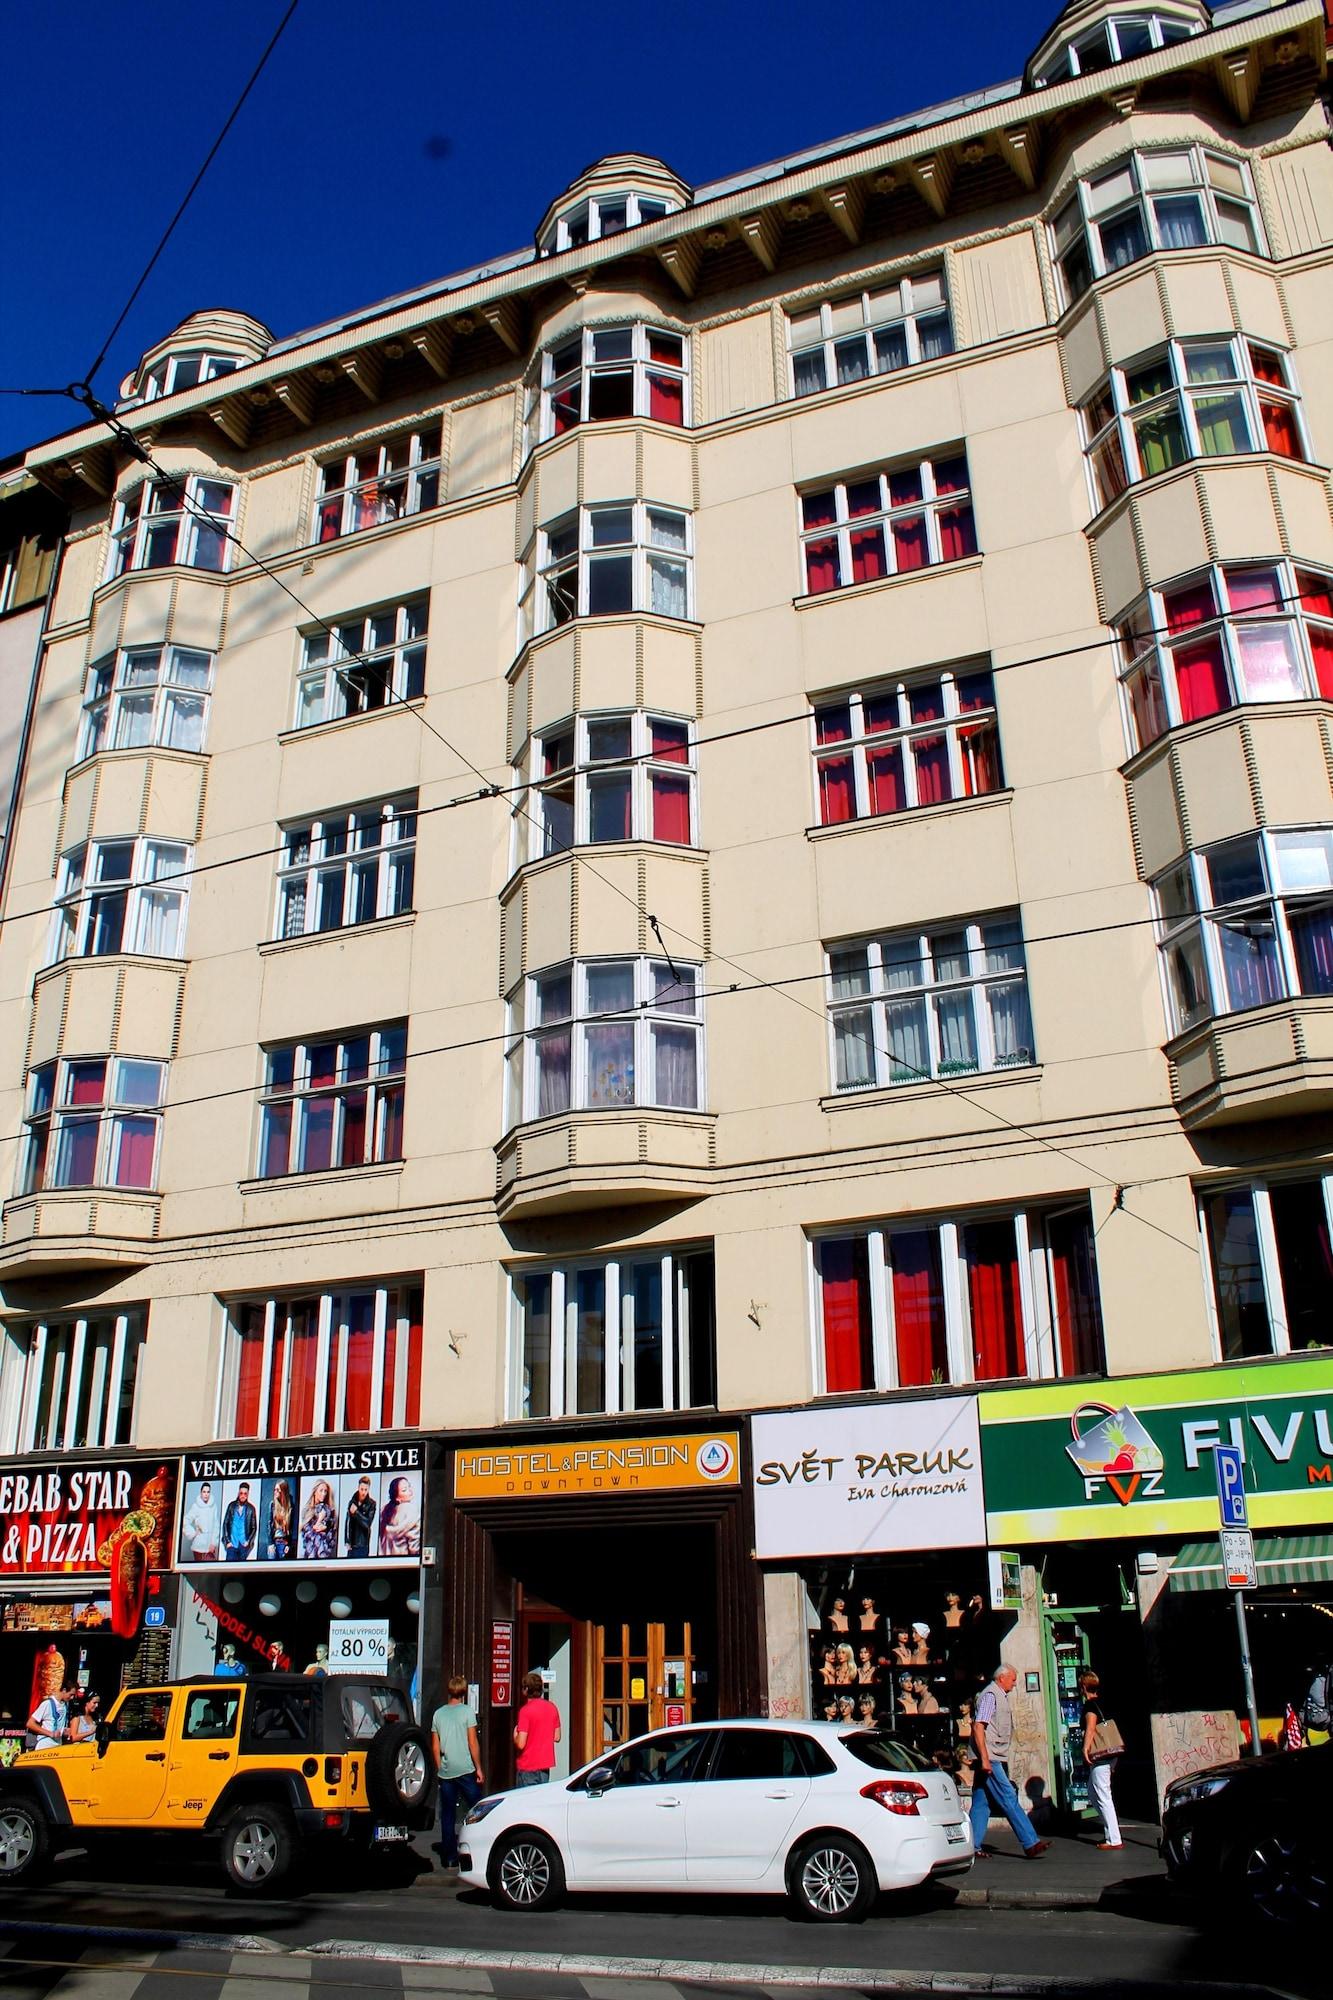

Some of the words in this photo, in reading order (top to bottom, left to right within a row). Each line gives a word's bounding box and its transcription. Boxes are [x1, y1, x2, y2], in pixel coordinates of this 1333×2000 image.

[191, 1458, 269, 1478] VENEZIA
[273, 1452, 356, 1474] LEATHER
[360, 1448, 419, 1469] STYLE
[756, 1448, 844, 1485] SVĚT
[854, 1447, 974, 1479] PARUK
[68, 1470, 132, 1511] STAR
[506, 1474, 639, 1491] DOWNTOWN
[847, 1486, 875, 1501] Eva
[880, 1478, 968, 1499] Charouzová
[1084, 1472, 1165, 1506] FVZ
[1221, 1455, 1238, 1500] P
[2, 1524, 21, 1564] &
[25, 1522, 97, 1563] PIZZA
[151, 1611, 160, 1622] 19
[341, 1639, 363, 1657] 80
[368, 1638, 386, 1657] %
[24, 1752, 60, 1760] RUBICON
[183, 1800, 203, 1811] Jeep
